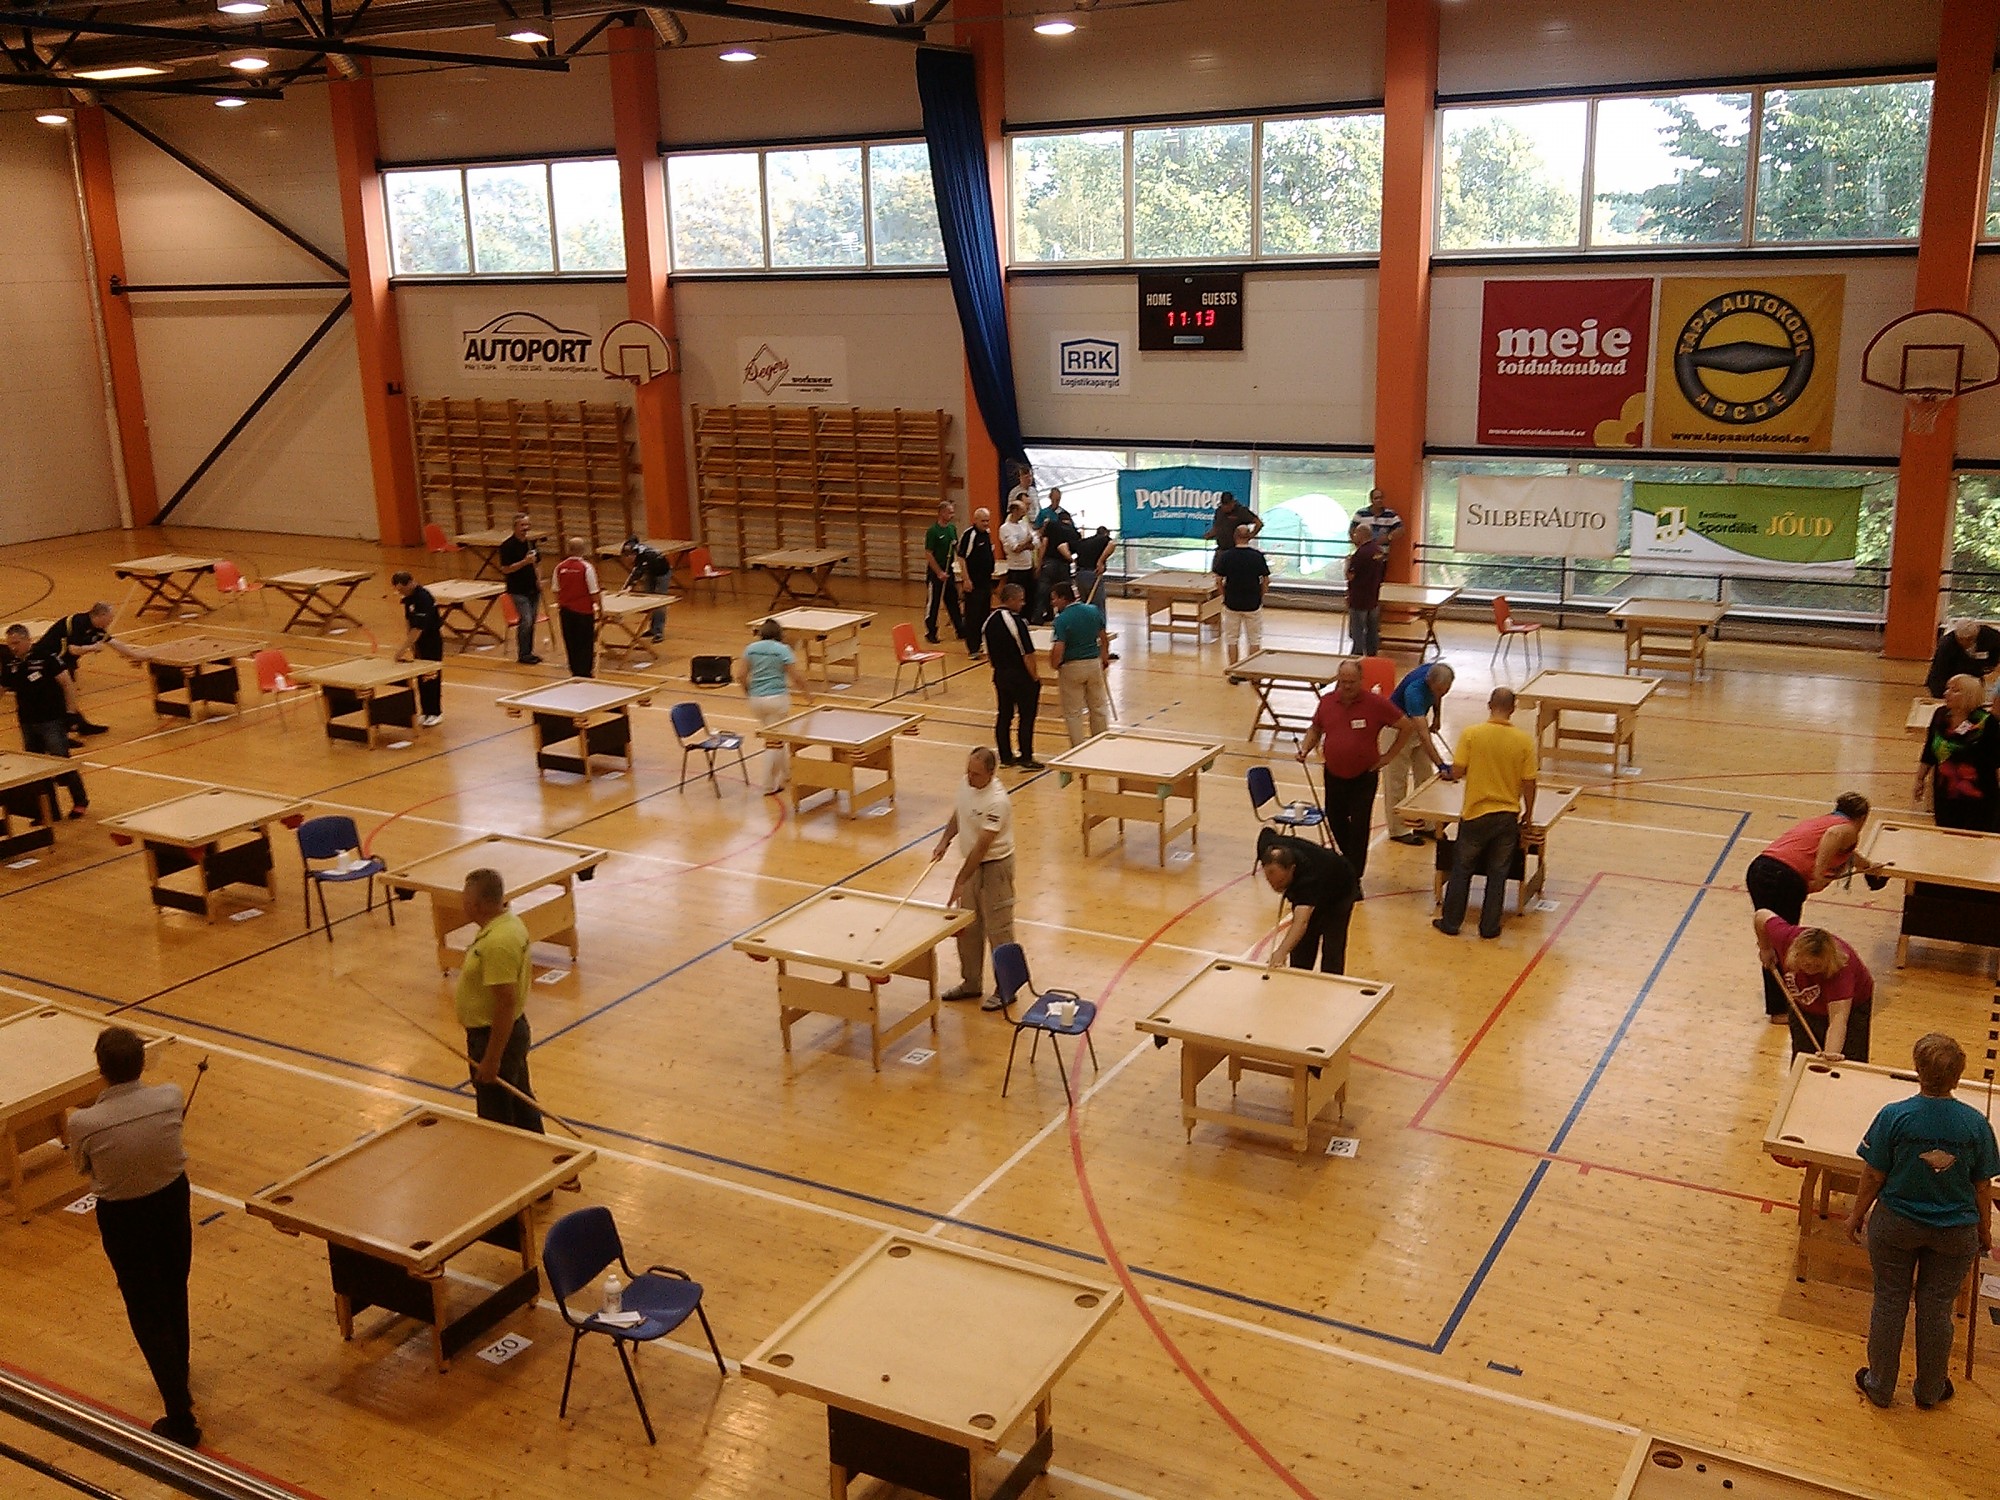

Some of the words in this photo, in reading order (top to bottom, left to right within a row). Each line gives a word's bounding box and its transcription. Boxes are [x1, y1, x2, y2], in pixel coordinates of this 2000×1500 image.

[1146, 293, 1172, 306] HOME
[1202, 292, 1238, 305] GUESTS
[1168, 309, 1215, 326] 11:13
[1679, 308, 1718, 354] TAPA
[1721, 295, 1810, 357] AUTOKOOL
[1496, 318, 1632, 358] meie
[464, 338, 593, 363] AUTOPORT
[1068, 351, 1113, 369] RRK
[1497, 359, 1628, 375] toidukaubad
[1061, 378, 1120, 388] Logistikapargid
[1671, 432, 1810, 443] www.tapaautokool.ee
[1135, 485, 1223, 510] Postimee
[1766, 511, 1834, 537] JÕUD
[487, 1339, 519, 1357] 30
